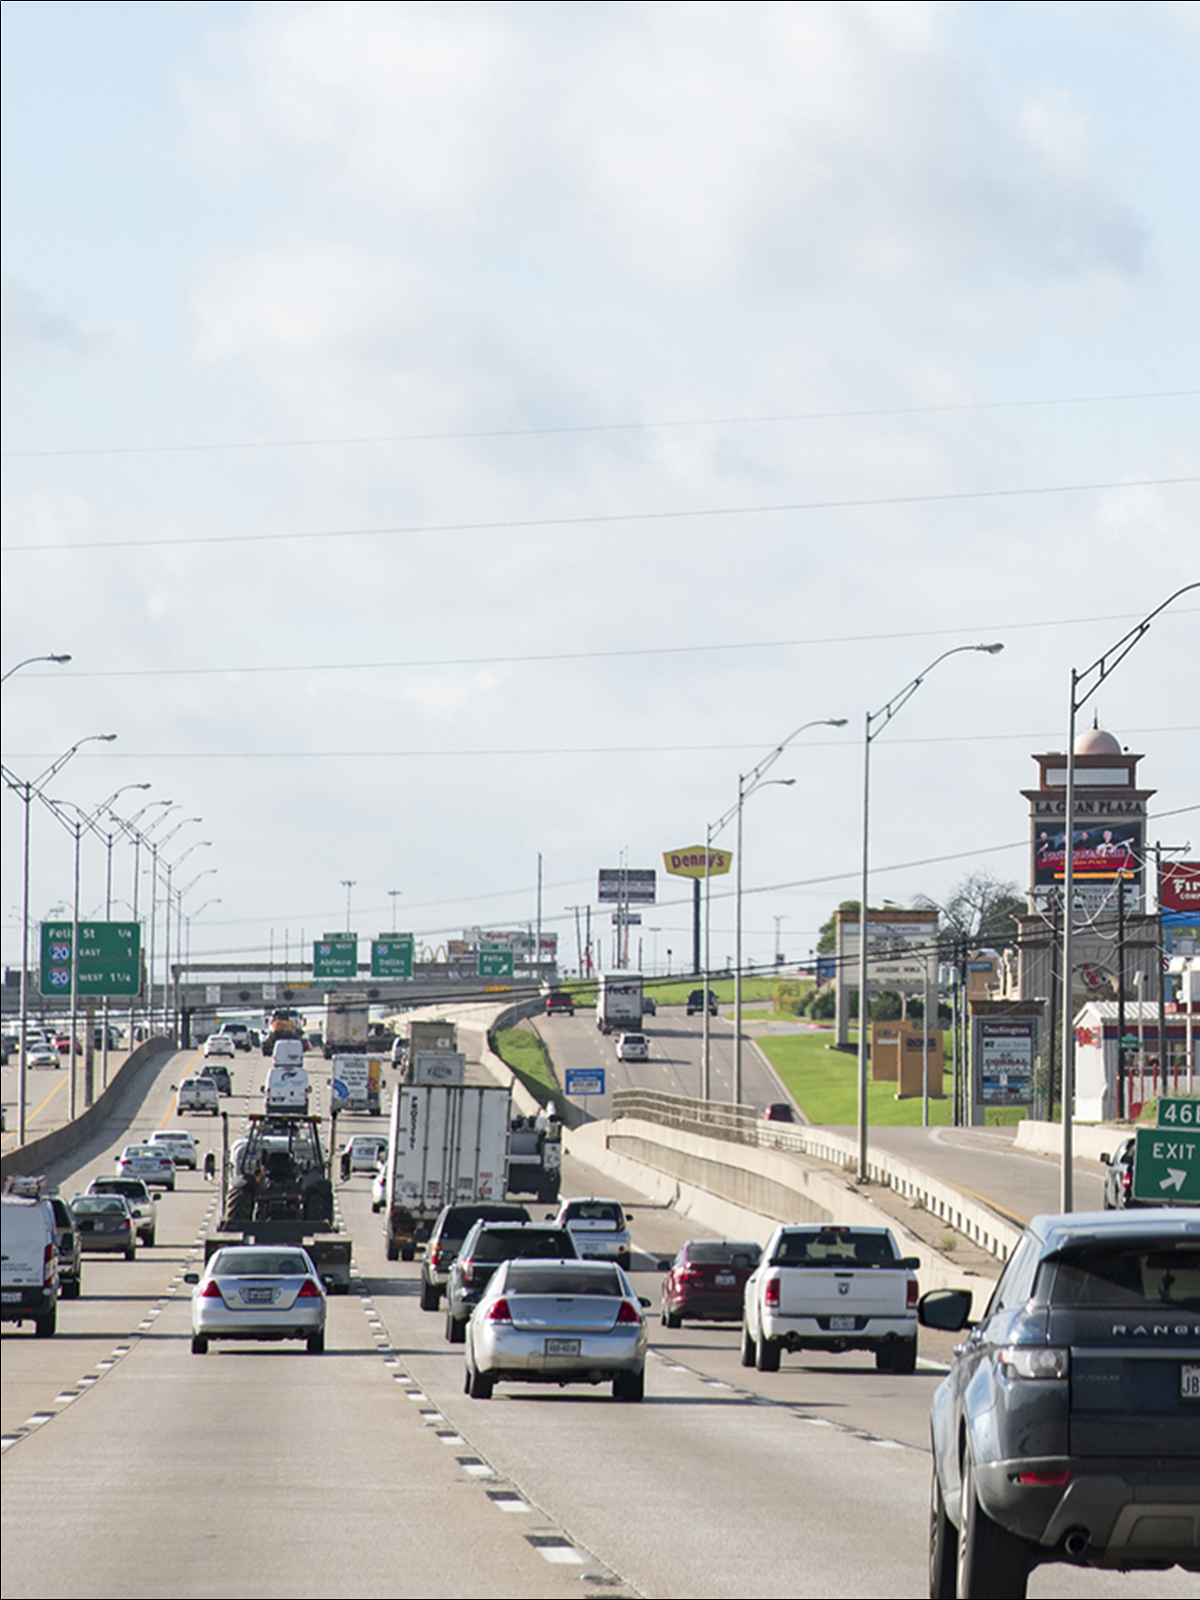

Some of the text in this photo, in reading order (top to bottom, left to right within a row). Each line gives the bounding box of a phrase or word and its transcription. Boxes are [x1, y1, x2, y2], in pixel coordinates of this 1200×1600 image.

[1035, 802, 1143, 813] LA GAN PLAZA
[670, 853, 725, 869] Denny's
[49, 928, 74, 938] Feli
[83, 928, 96, 939] St
[53, 947, 70, 960] 20
[53, 972, 69, 985] 20
[1152, 1142, 1196, 1160] EXIT
